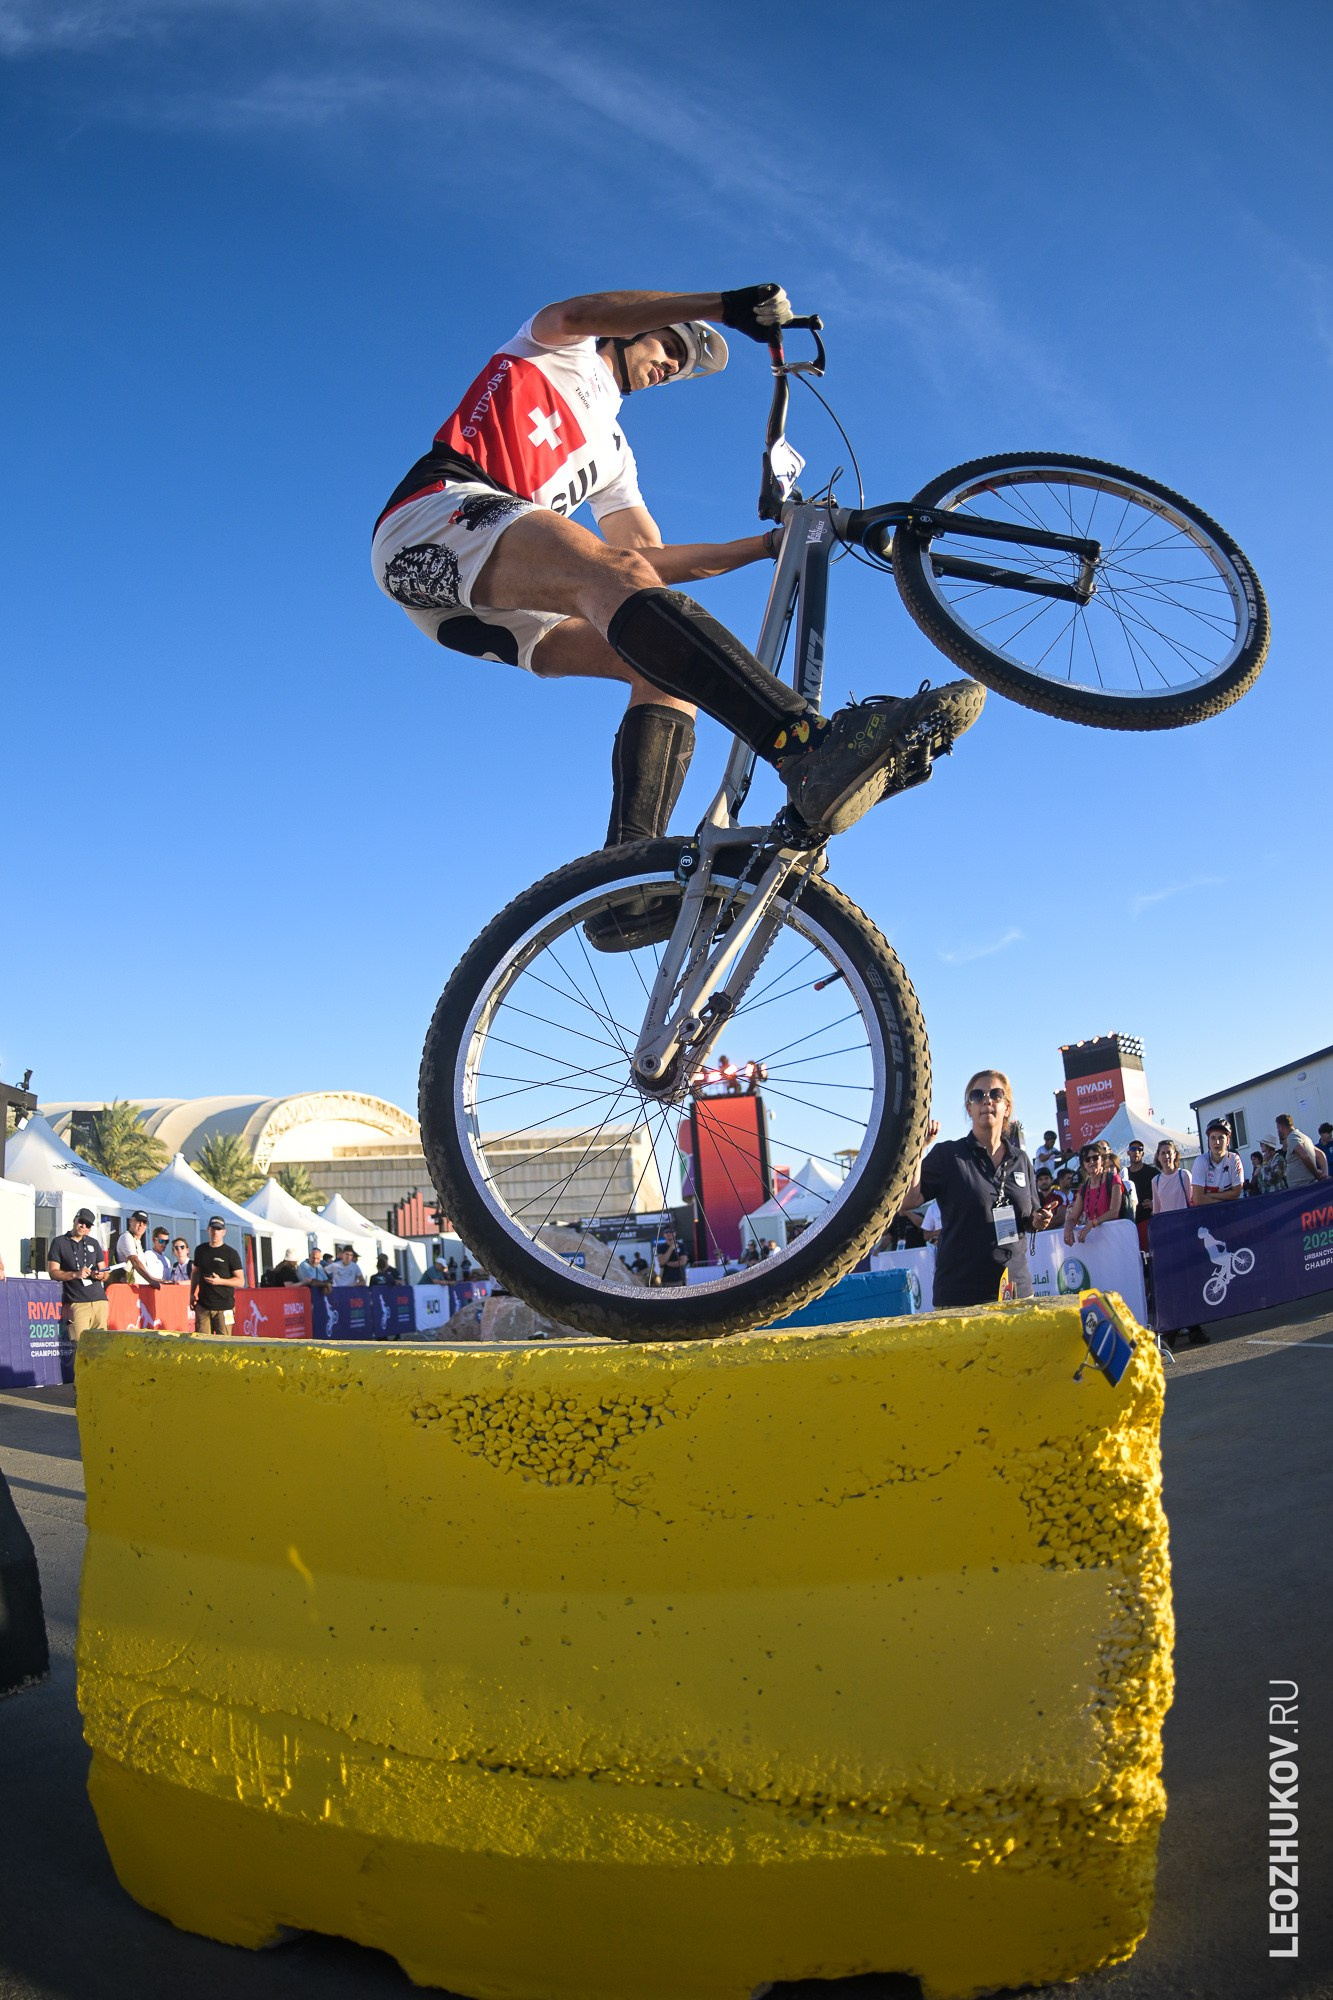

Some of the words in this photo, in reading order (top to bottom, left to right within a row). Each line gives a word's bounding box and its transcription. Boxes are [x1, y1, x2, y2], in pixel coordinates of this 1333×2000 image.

[470, 373, 507, 423] TUDOR
[575, 387, 590, 410] TUDOR
[551, 460, 598, 516] SUI
[1241, 574, 1256, 602] TIRE
[876, 990, 900, 1033] TIRE
[1076, 1079, 1113, 1096] RIYADH
[1304, 1250, 1323, 1261] URBAN
[29, 1324, 55, 1338] 2025
